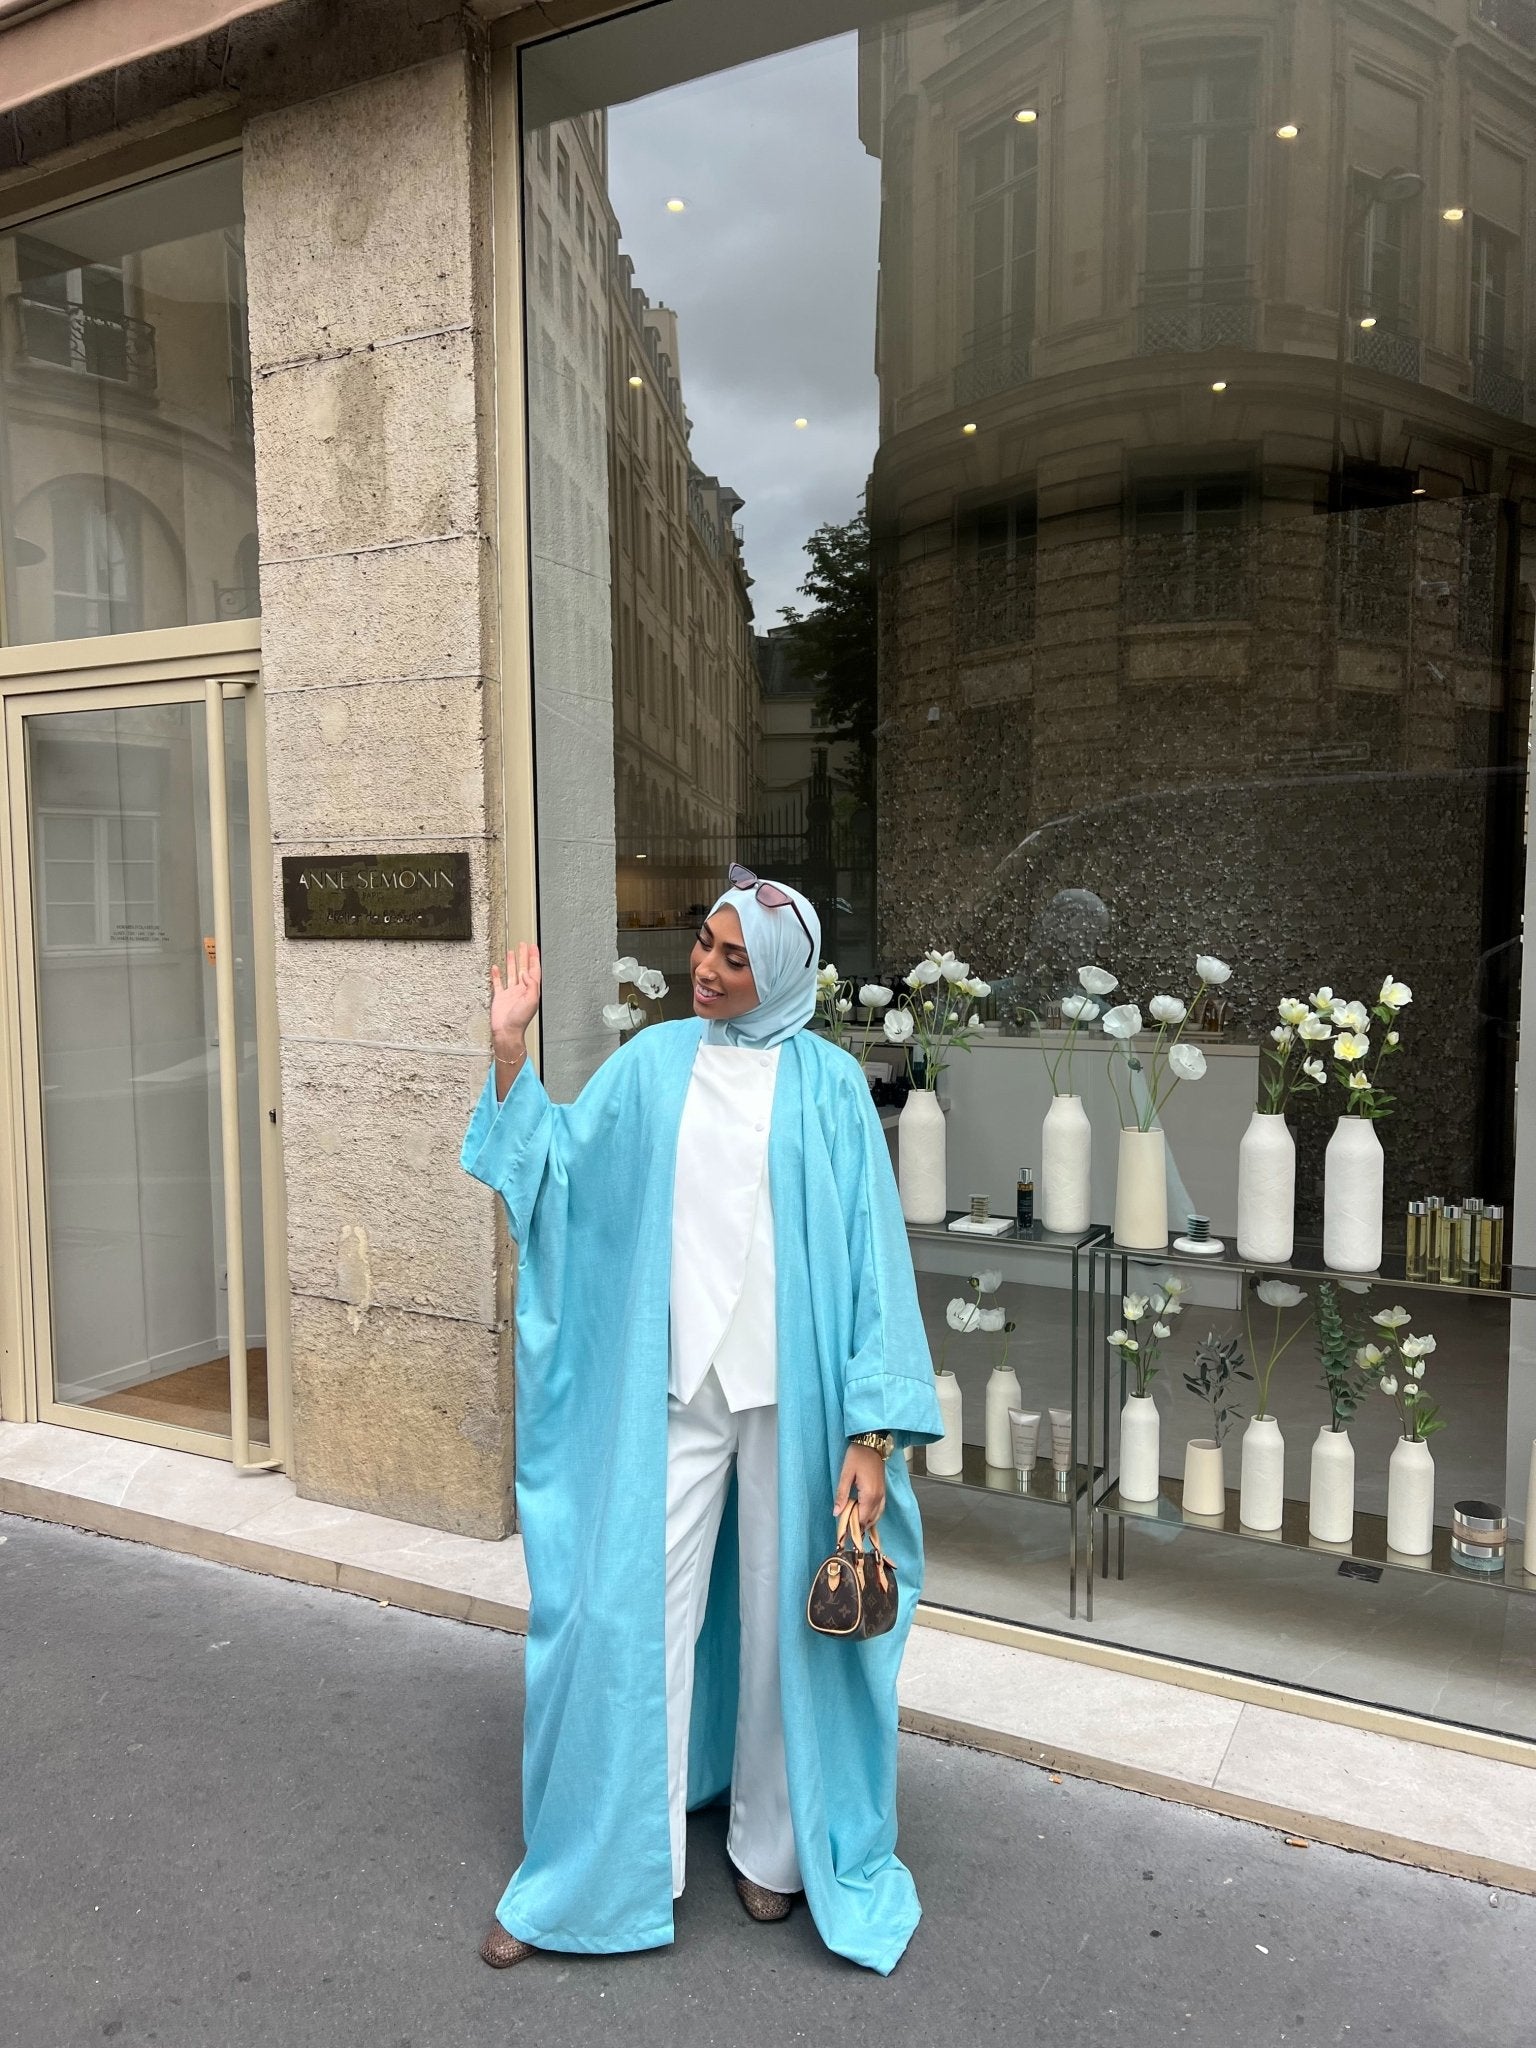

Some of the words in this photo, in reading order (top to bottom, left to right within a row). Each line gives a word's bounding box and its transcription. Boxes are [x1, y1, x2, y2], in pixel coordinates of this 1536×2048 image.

[299, 870, 347, 890] ANNE
[357, 868, 454, 889] SEMONIN
[362, 891, 384, 901] PARIS
[366, 910, 379, 925] de
